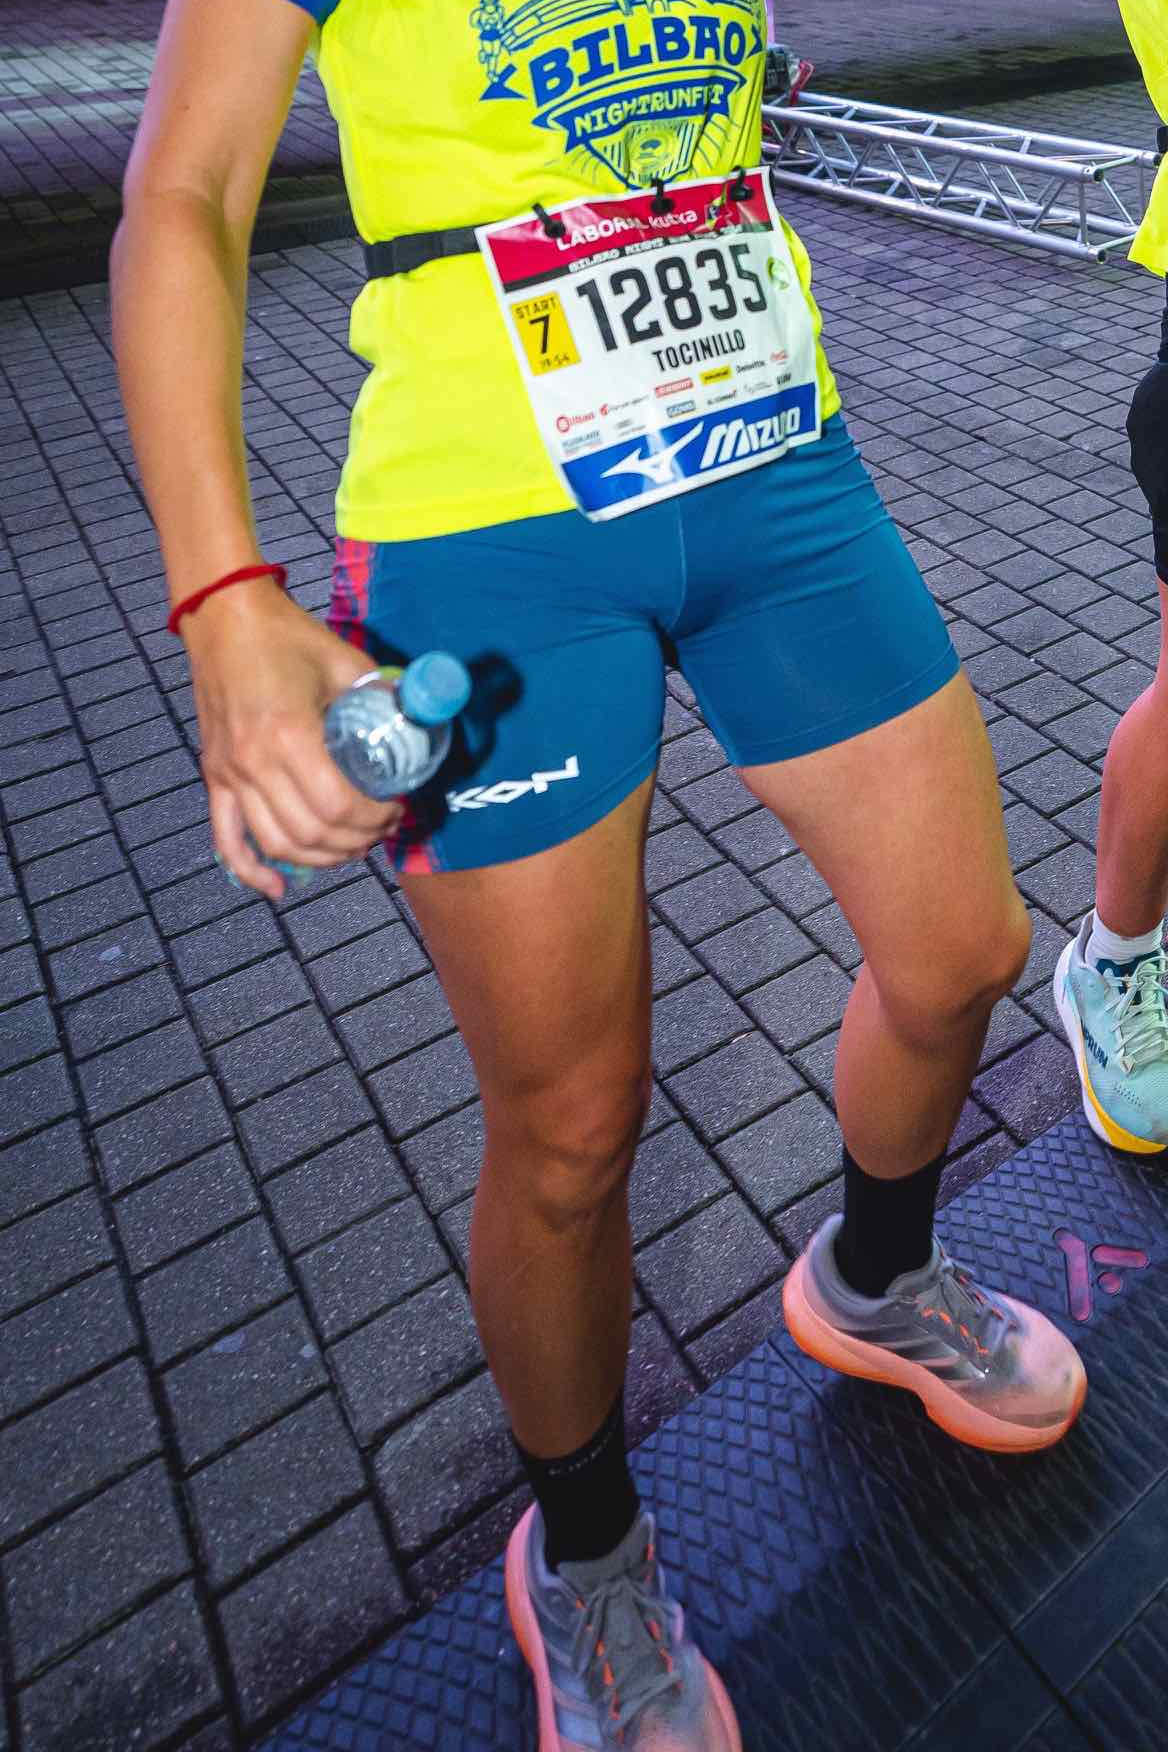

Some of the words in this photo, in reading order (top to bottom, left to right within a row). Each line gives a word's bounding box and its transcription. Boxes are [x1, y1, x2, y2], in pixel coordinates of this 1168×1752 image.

[528, 15, 747, 109] BILBAO
[648, 209, 698, 230] kutxa
[515, 296, 557, 320] START
[576, 242, 768, 352] 12835
[528, 314, 550, 355] 7
[652, 329, 746, 373] TOCINILLO
